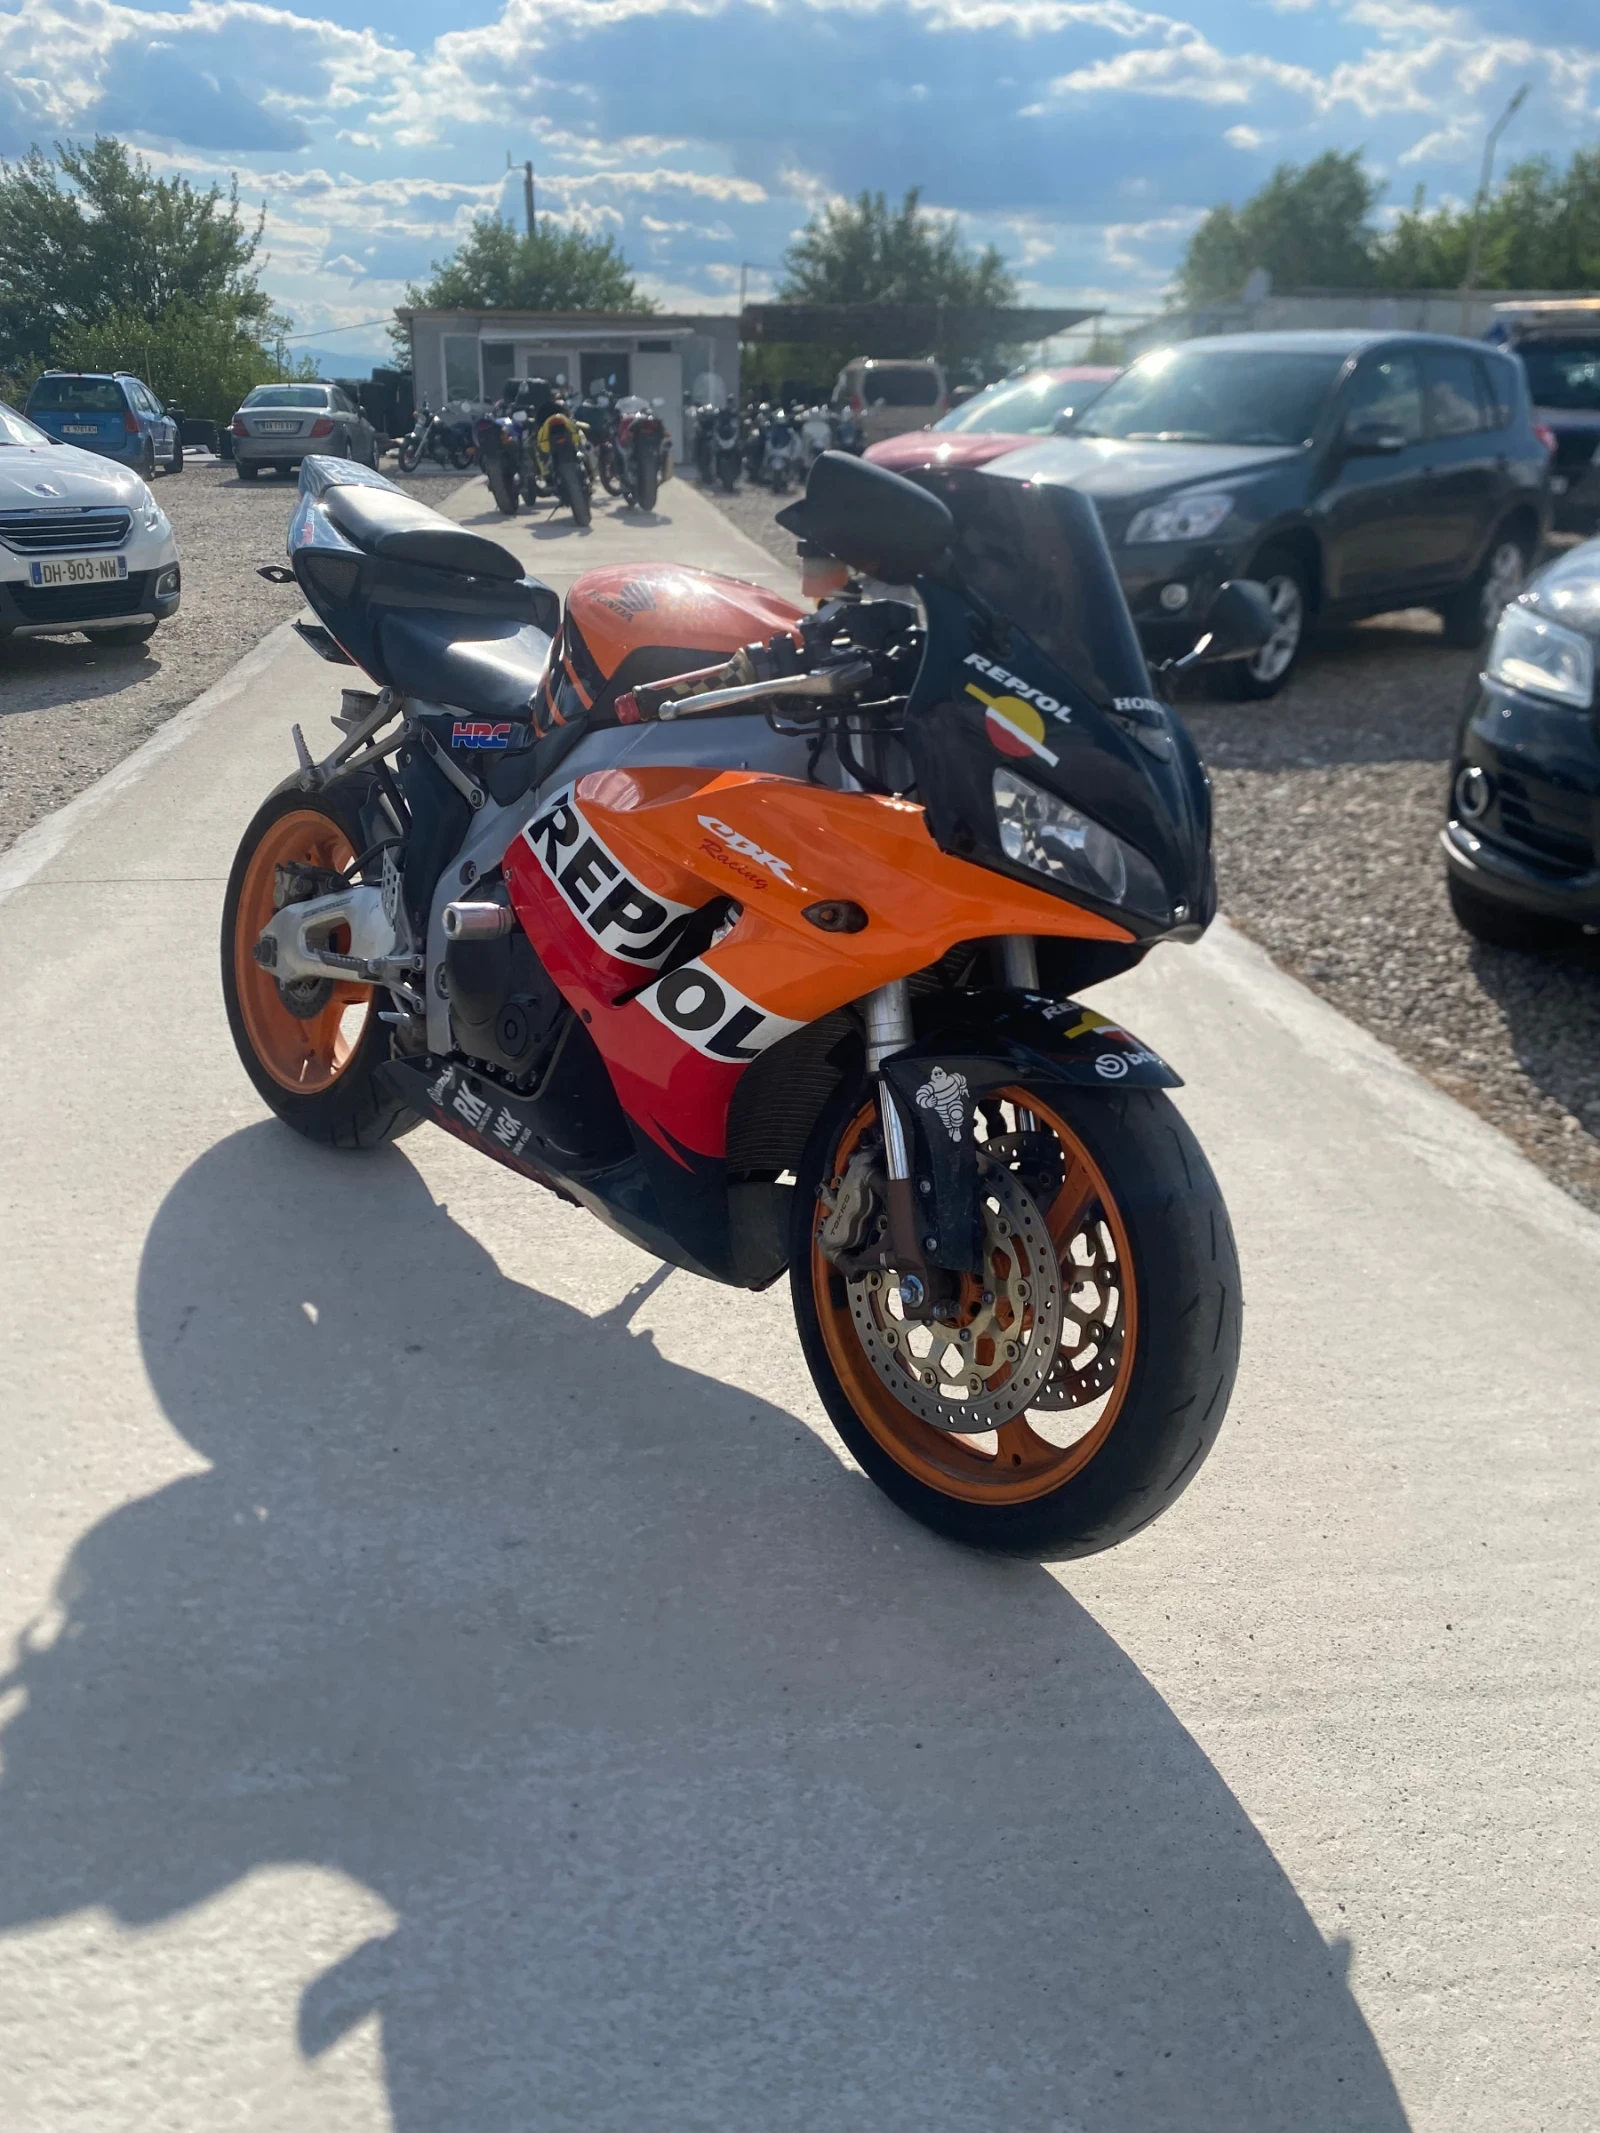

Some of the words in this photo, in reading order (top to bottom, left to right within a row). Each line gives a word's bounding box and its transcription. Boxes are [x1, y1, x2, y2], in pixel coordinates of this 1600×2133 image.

[963, 653, 1072, 724] REPSOL
[452, 722, 511, 748] HRC
[697, 814, 797, 889] CBR
[699, 838, 768, 890] Racing
[452, 1080, 487, 1127] RK
[492, 1106, 522, 1147] NGK
[830, 1193, 850, 1236] TOKICO
